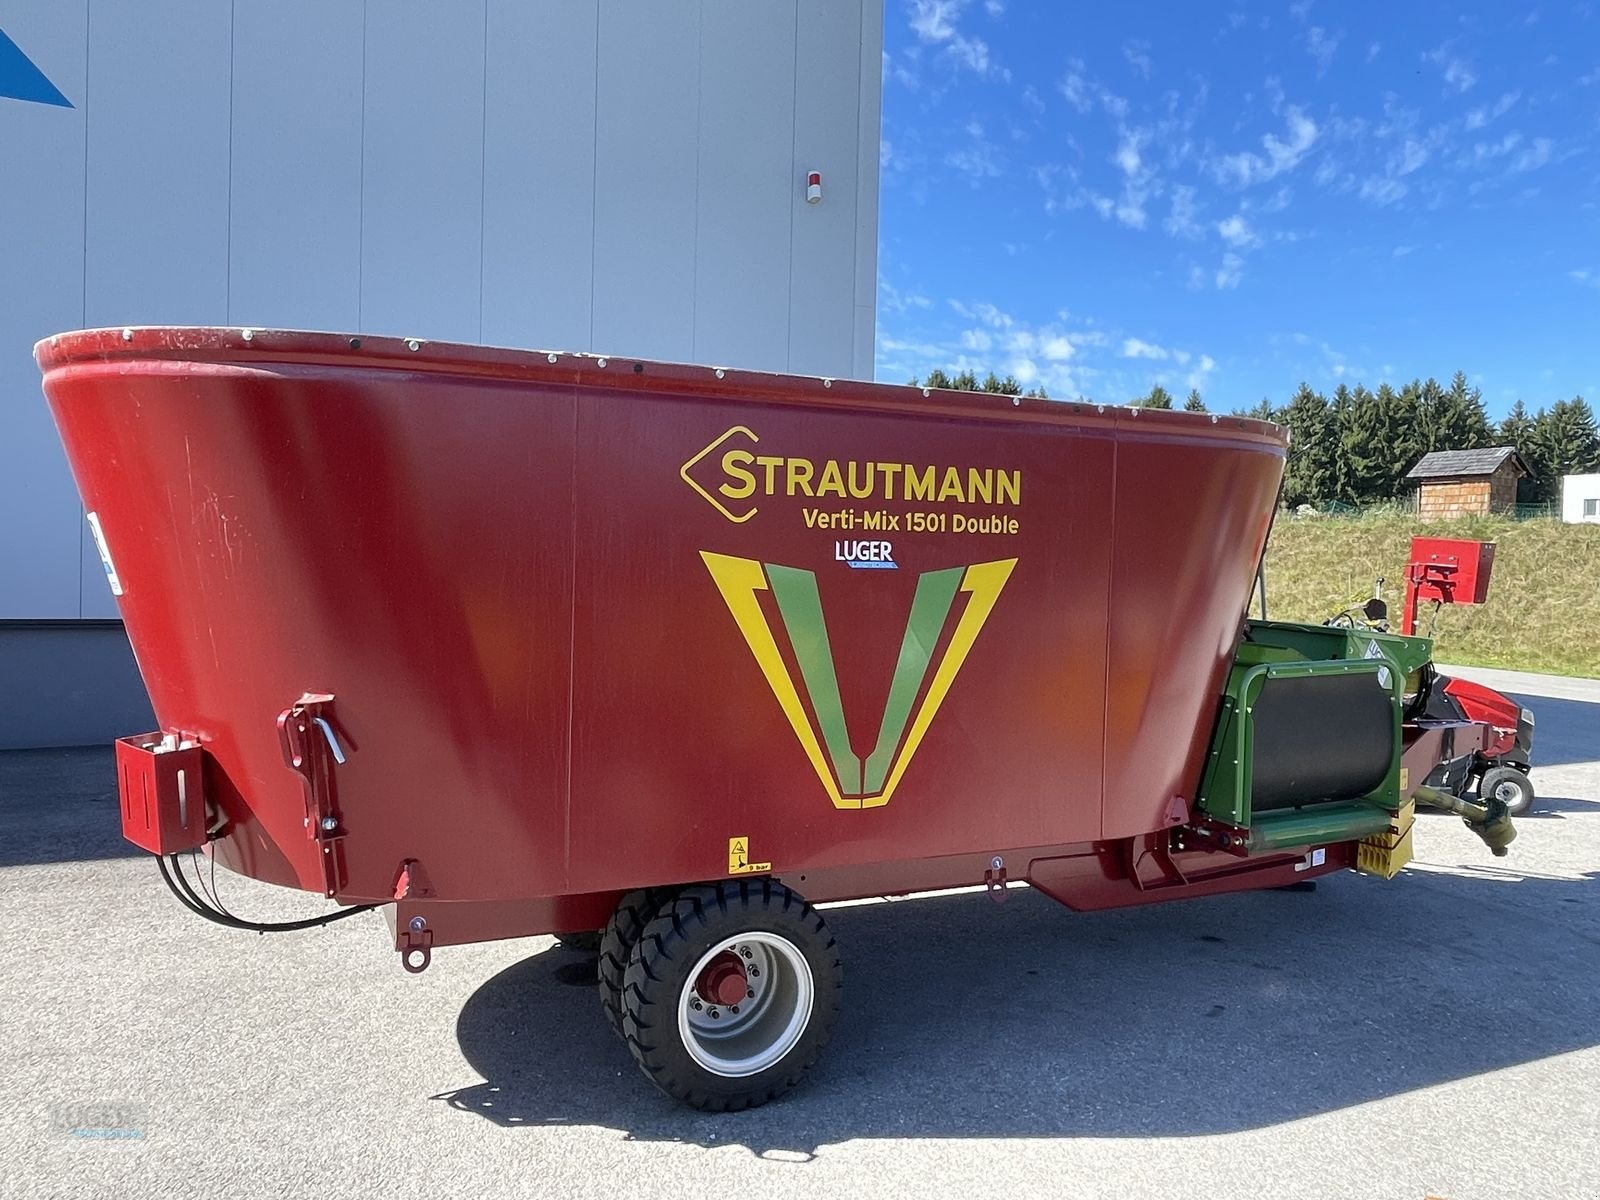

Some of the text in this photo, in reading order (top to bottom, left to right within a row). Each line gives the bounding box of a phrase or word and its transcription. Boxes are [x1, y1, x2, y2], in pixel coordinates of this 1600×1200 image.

[718, 449, 1022, 506] STRAUTMANN
[802, 508, 1020, 535] Verti-Mix 1501 Double
[835, 540, 894, 562] LUGER
